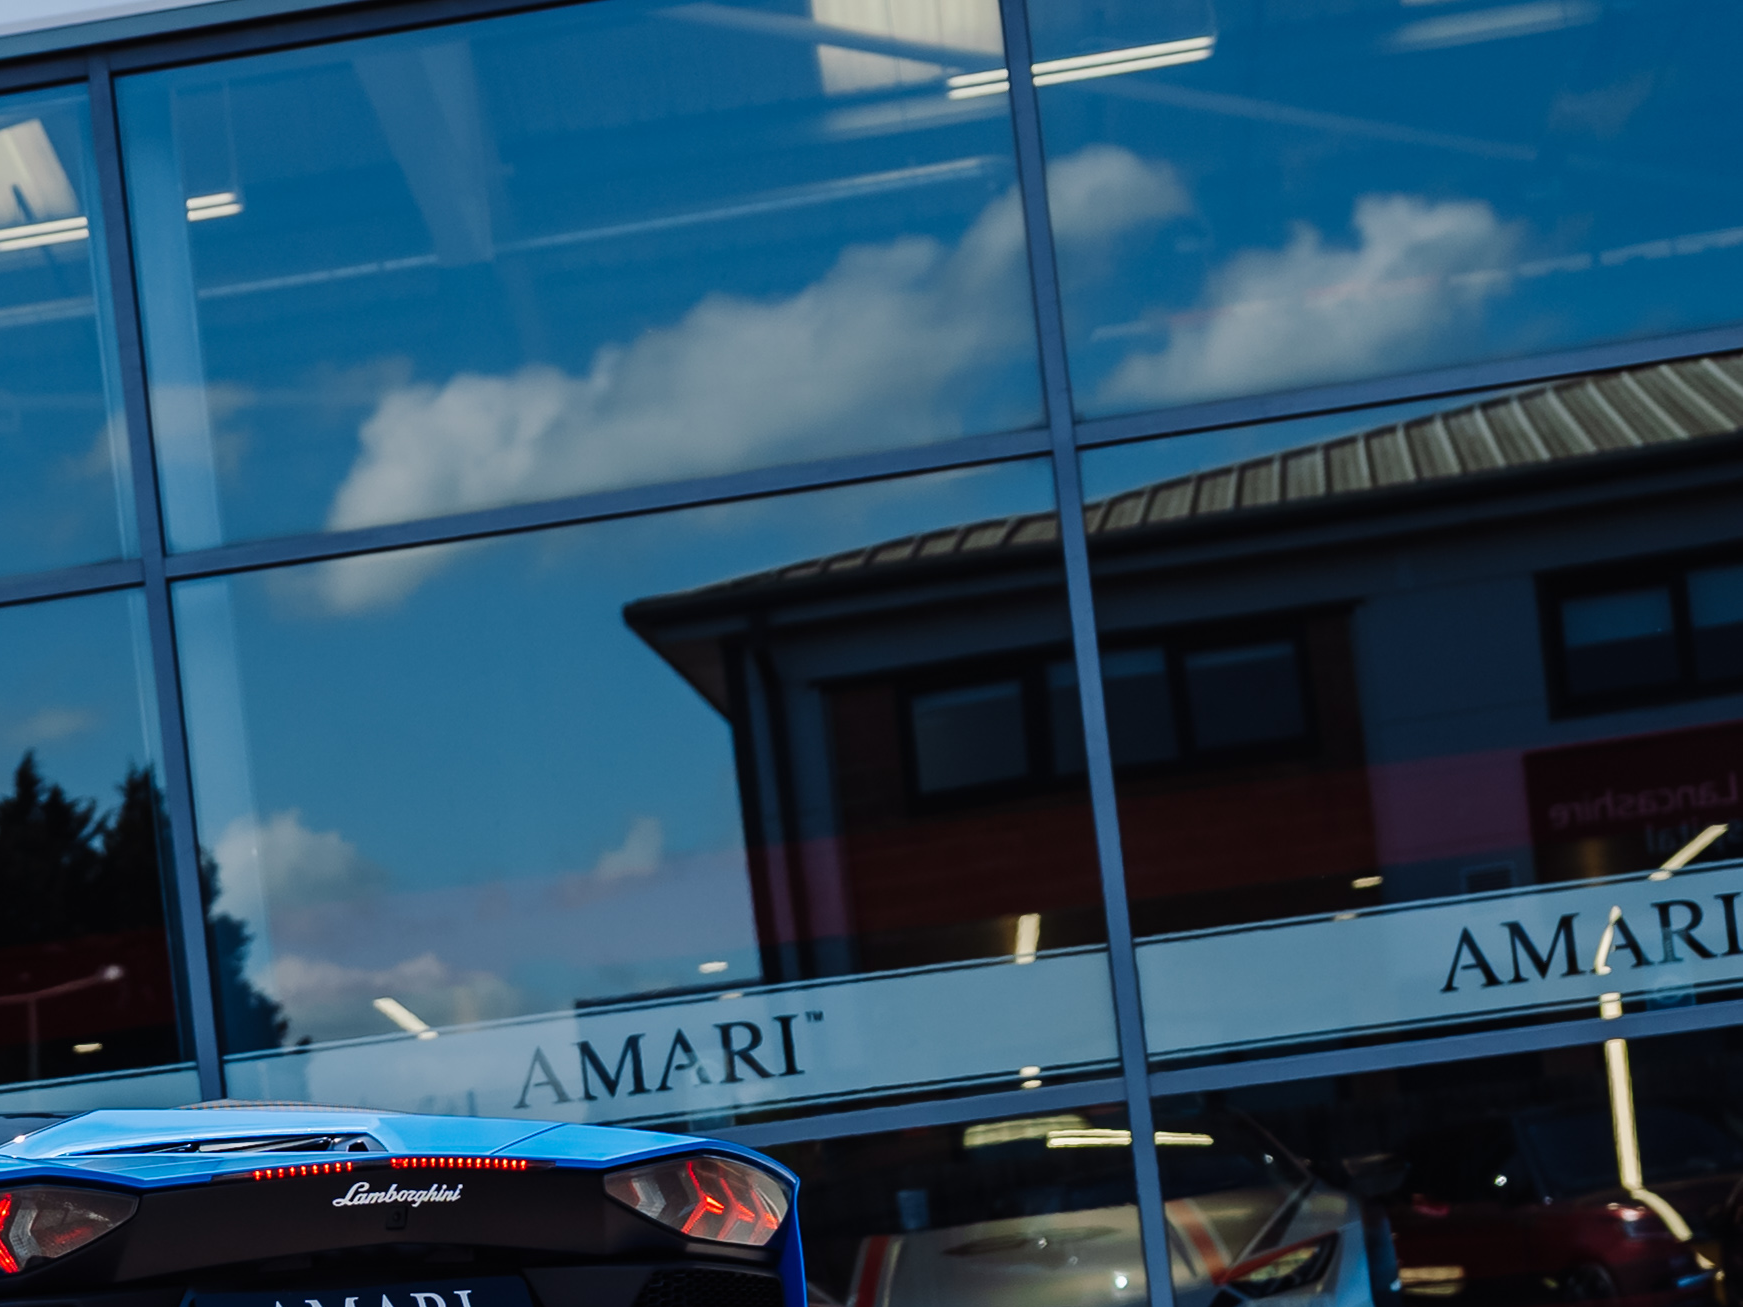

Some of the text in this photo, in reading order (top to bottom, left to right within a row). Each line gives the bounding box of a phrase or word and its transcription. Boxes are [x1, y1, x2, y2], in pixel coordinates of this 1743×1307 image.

[1440, 892, 1743, 993] AMARI
[512, 1014, 805, 1109] AMARI
[332, 1181, 463, 1207] Lamborghini
